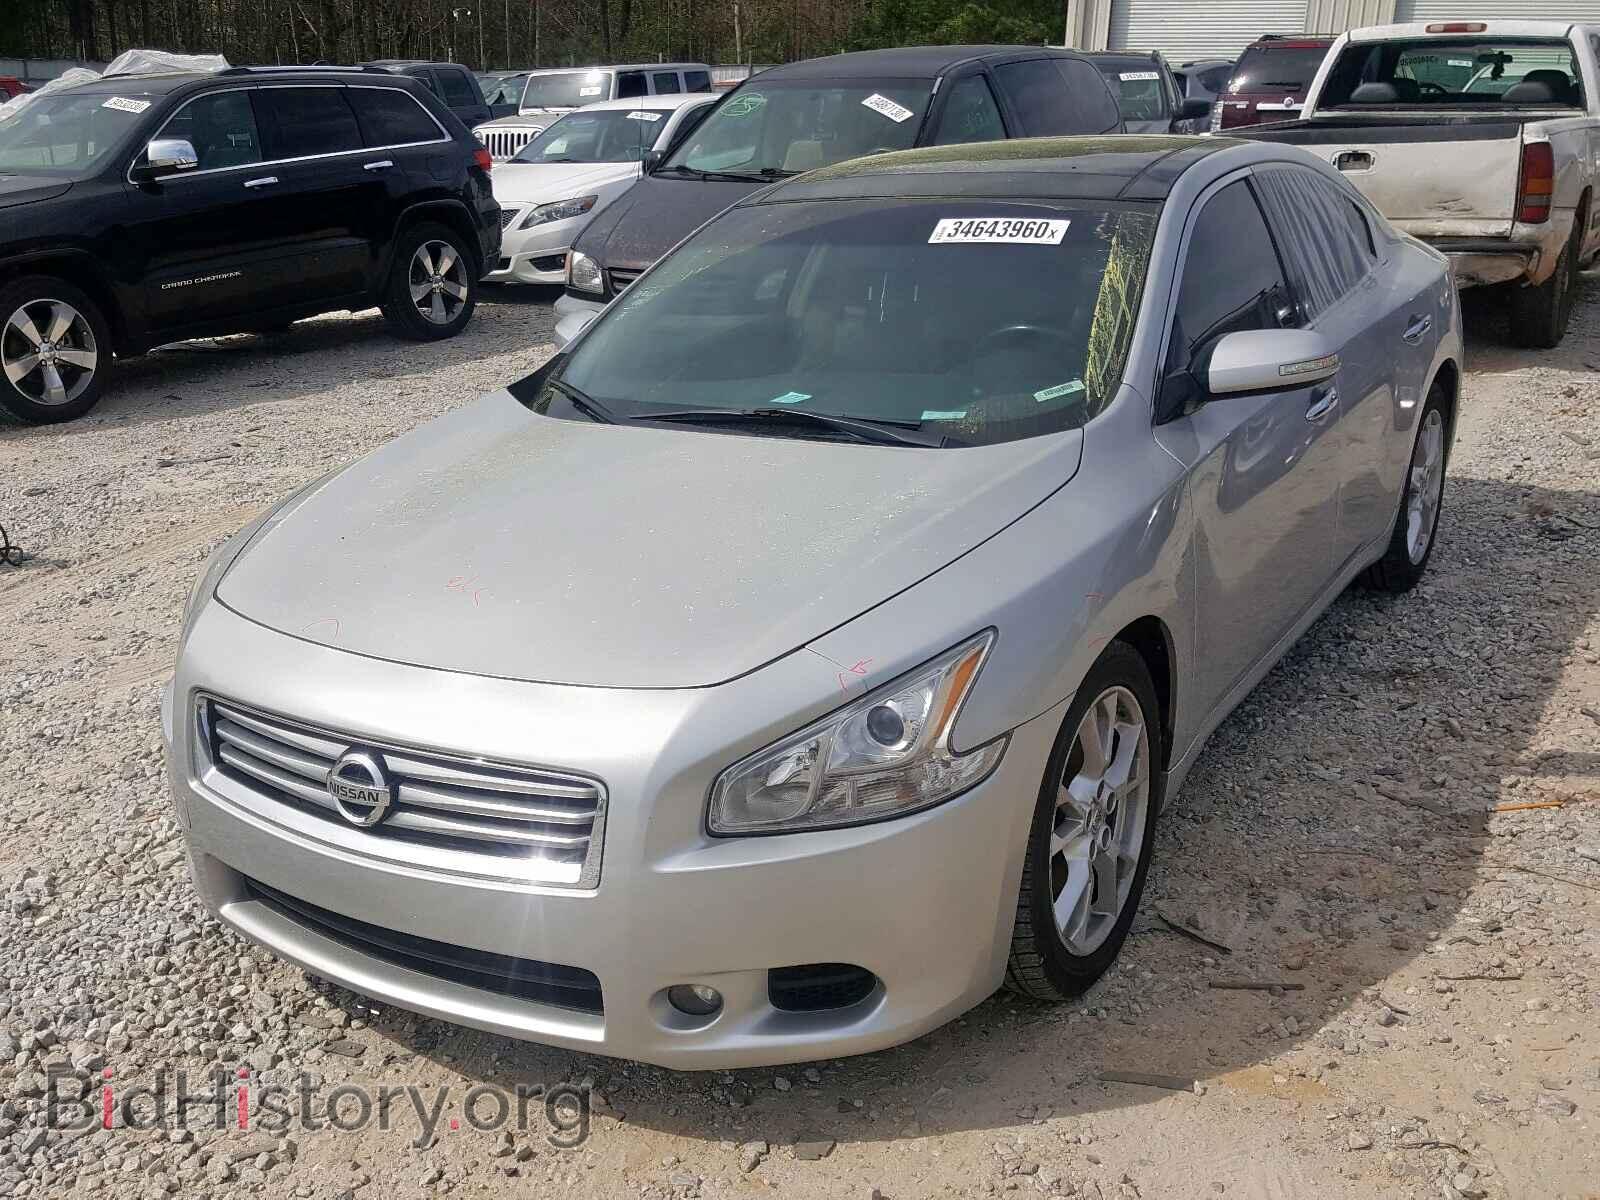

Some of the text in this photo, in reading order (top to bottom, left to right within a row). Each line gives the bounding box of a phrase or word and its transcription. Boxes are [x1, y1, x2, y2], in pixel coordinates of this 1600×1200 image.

[161, 271, 243, 290] GRAND CHEROKEE
[329, 781, 380, 802] NISSAN
